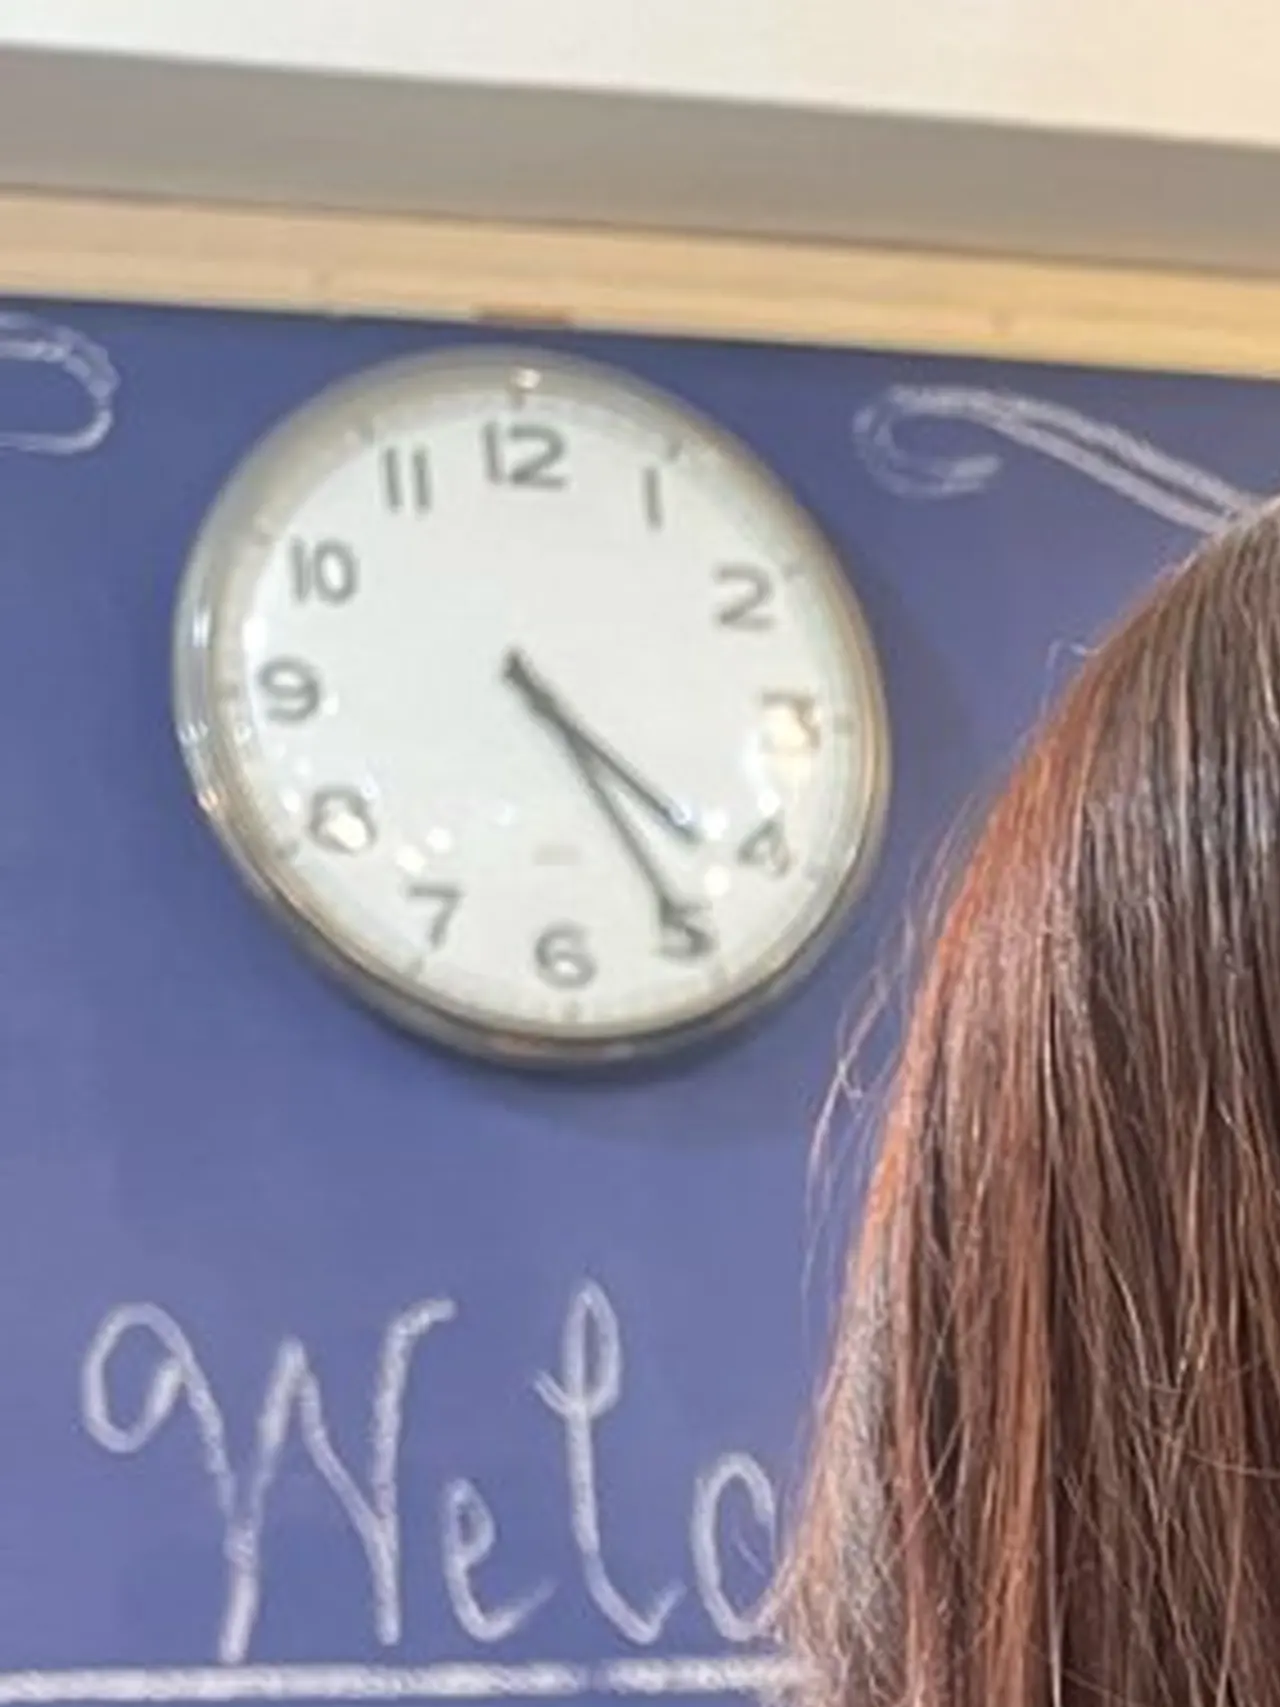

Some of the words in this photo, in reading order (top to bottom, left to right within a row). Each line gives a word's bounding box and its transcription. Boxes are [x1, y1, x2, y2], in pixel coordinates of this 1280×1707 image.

[379, 447, 432, 513] 11
[480, 420, 567, 489] 12
[642, 466, 663, 527] 1
[288, 536, 358, 604] 10
[713, 564, 774, 630] 2
[256, 658, 320, 722] 9
[740, 818, 794, 876] 4
[408, 883, 462, 947] 7
[658, 903, 714, 960] 5
[535, 923, 595, 989] 6
